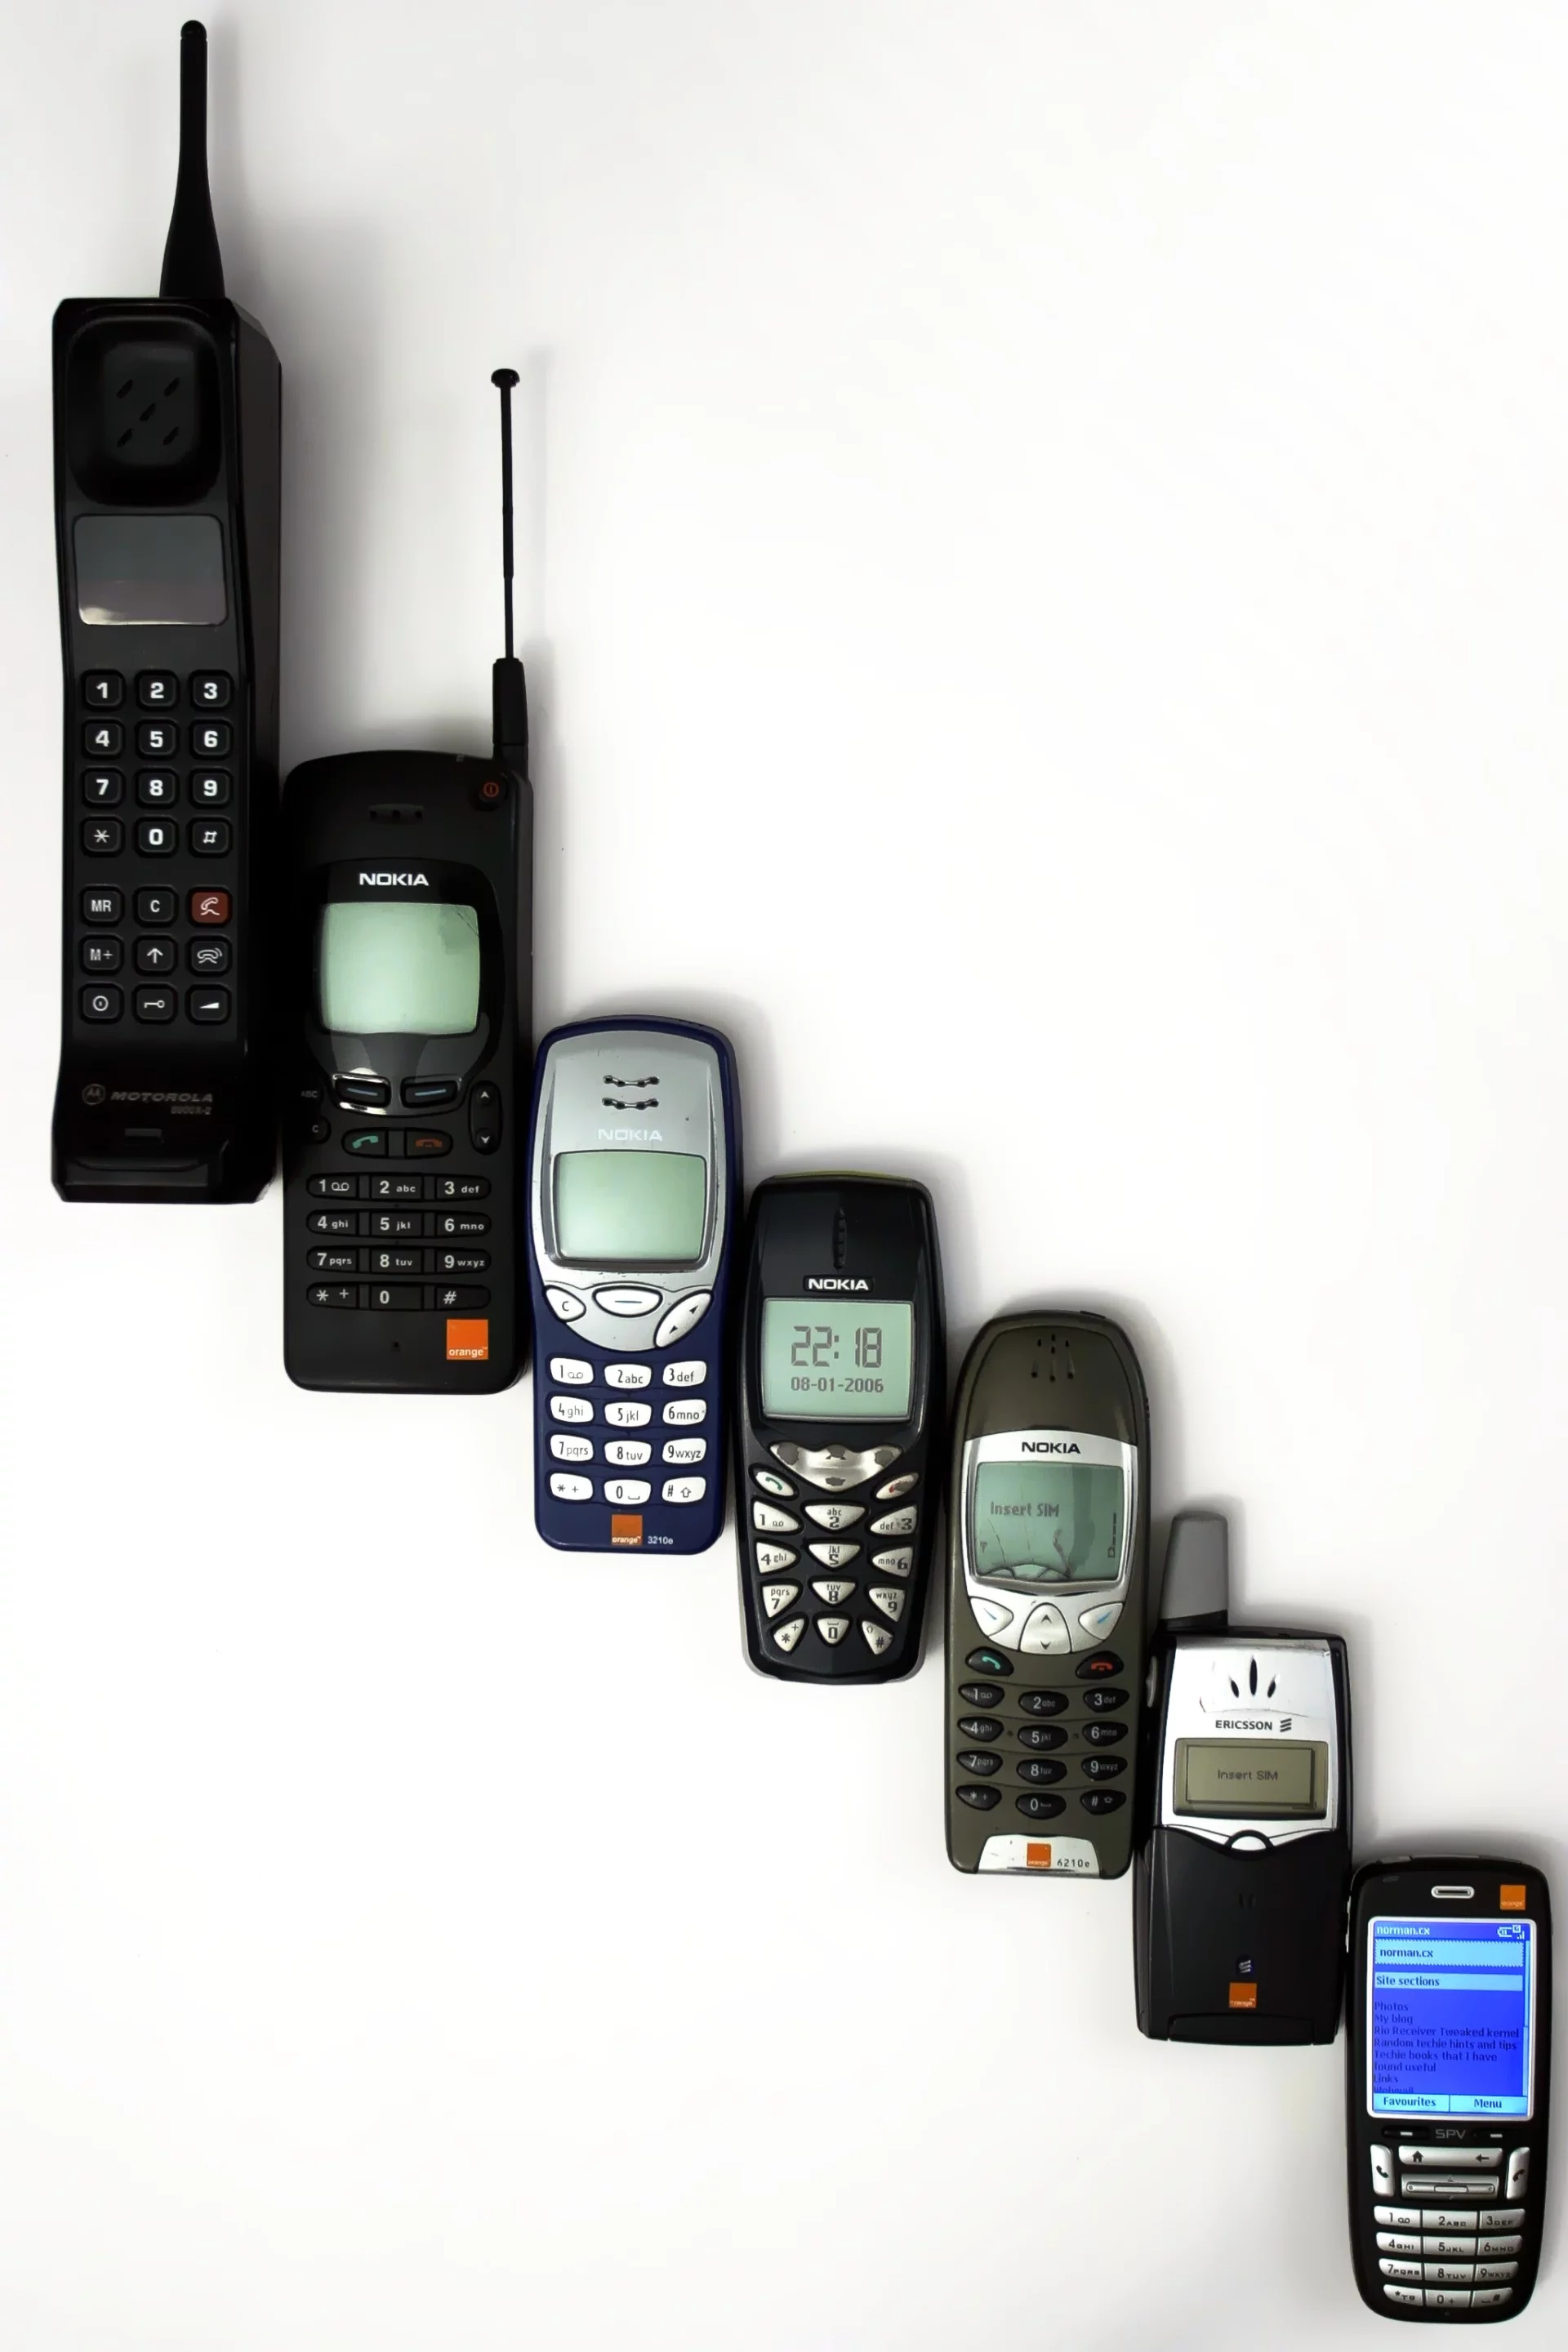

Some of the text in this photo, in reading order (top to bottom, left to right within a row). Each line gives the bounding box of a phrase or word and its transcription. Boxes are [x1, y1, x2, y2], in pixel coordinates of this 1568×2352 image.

[96, 683, 108, 698] 1
[150, 682, 164, 698] 2
[203, 683, 217, 699] 3
[96, 730, 109, 746] 4
[150, 731, 163, 747] 5
[203, 730, 218, 747] 6
[96, 779, 109, 795] 7
[149, 780, 163, 796] 8
[203, 780, 217, 796] 9
[149, 829, 163, 844] 0
[359, 873, 429, 886] NOKIA
[91, 900, 111, 912] MR
[150, 900, 160, 912] C
[111, 1092, 212, 1102] MOTOROLA
[598, 1129, 662, 1141] NOKIA
[319, 1179, 326, 1192] 1
[808, 1278, 869, 1290] NOKIA
[562, 1301, 569, 1312] C
[791, 1377, 884, 1392] 08-01-2006
[1022, 1442, 1080, 1454] NOKIA
[991, 1502, 1060, 1517] Insert SIM
[760, 1514, 765, 1526] 1
[1215, 1720, 1272, 1730] ERICSSON
[1218, 1770, 1278, 1780] Insert SIM
[1058, 1859, 1090, 1868] 6210e
[1376, 1926, 1430, 1935] norman.cx
[1379, 1949, 1433, 1958] norman.cx
[1376, 1976, 1440, 1986] Site sections
[1374, 2002, 1408, 2011] Photos
[1374, 2015, 1413, 2025] My blog
[1392, 2027, 1436, 2036] Receiver
[1441, 2028, 1484, 2037] Tweaked
[1487, 2029, 1518, 2038] kernel
[1374, 2038, 1517, 2051] Random techie hints and tips
[1374, 2051, 1405, 2060] Techie
[1409, 2051, 1438, 2060] books
[1442, 2052, 1463, 2060] that
[1472, 2053, 1497, 2062] have
[1374, 2063, 1436, 2072] found useful
[1374, 2074, 1398, 2082] Links
[1383, 2097, 1436, 2106] Favourites
[1474, 2099, 1502, 2109] Menu
[1436, 2129, 1467, 2139] SPV
